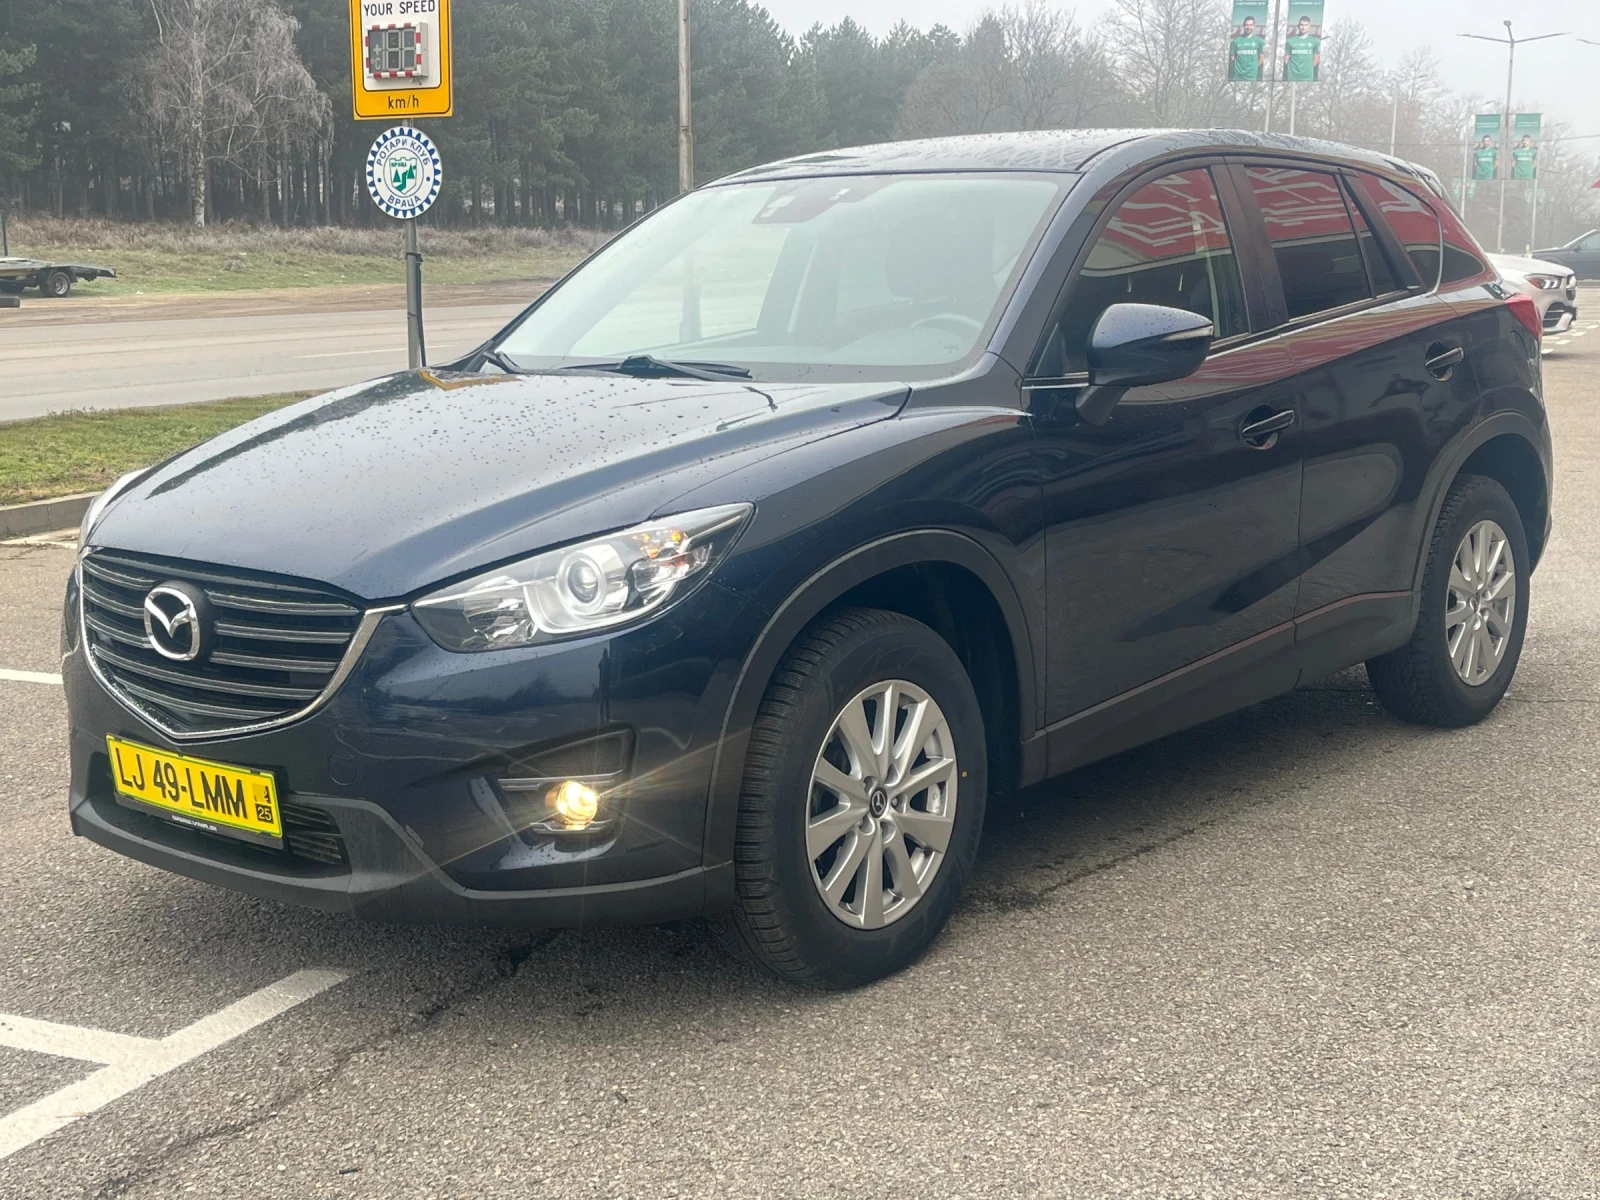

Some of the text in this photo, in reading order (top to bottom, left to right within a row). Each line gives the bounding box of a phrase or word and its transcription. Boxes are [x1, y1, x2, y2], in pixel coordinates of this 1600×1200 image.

[363, 0, 435, 17] YOUR SPEED
[388, 94, 419, 109] km/h
[376, 138, 431, 167] РОТАРИ КЛУБ
[387, 195, 422, 208] ВРАЦА
[115, 747, 249, 820] LJ 49-LMM
[257, 806, 272, 821] 25
